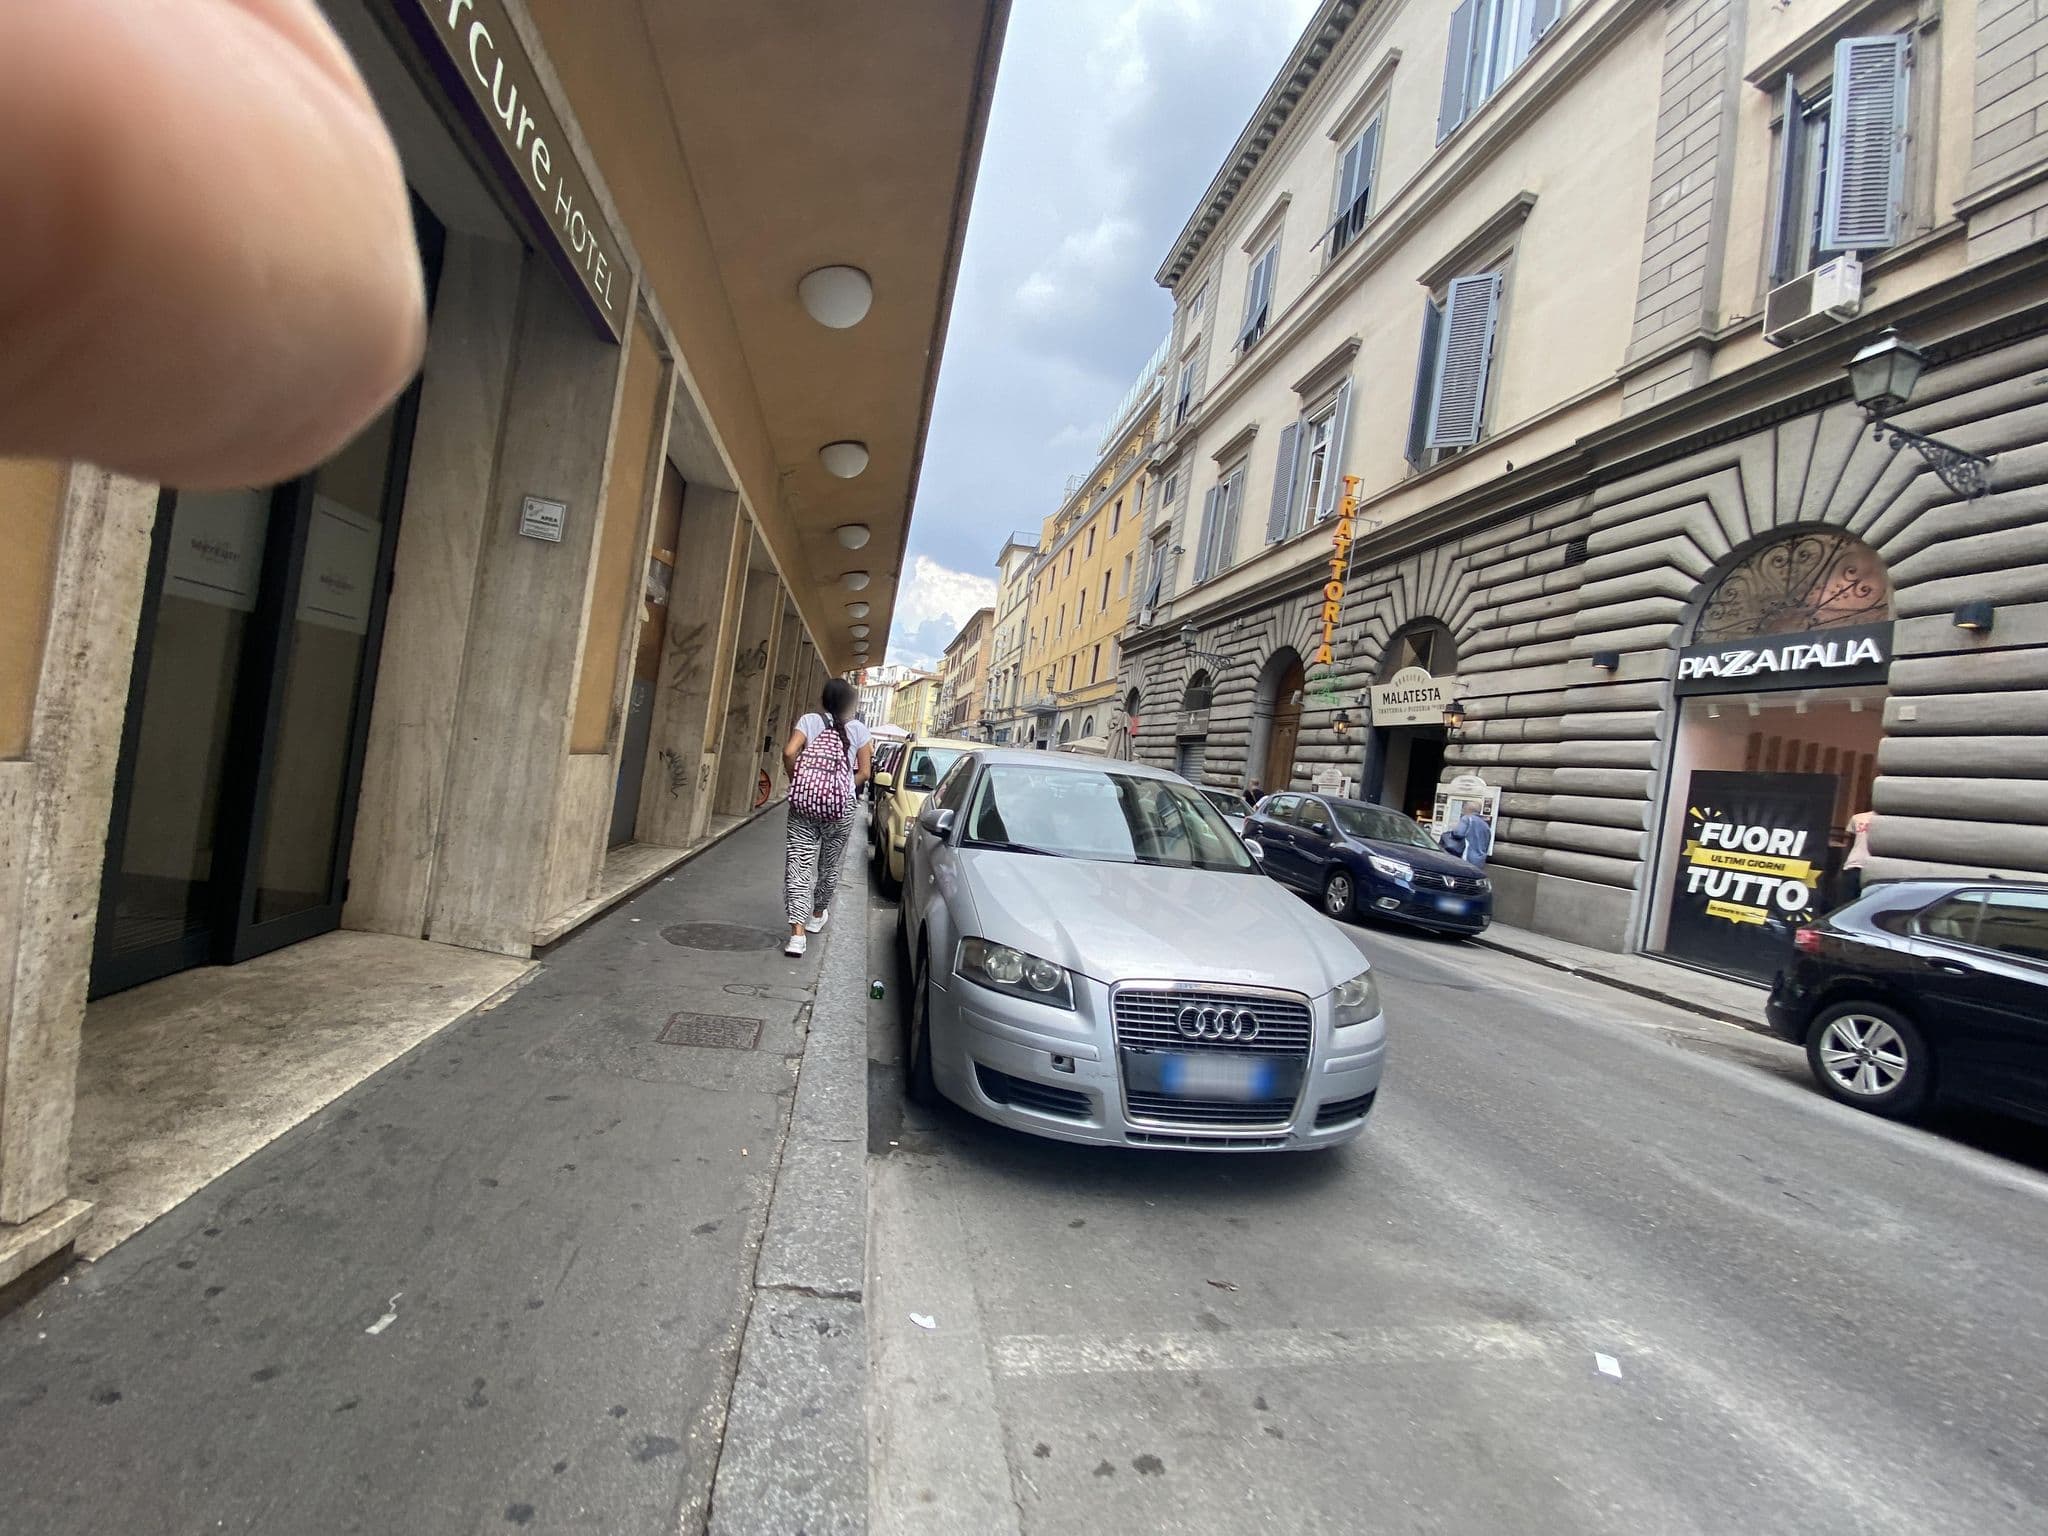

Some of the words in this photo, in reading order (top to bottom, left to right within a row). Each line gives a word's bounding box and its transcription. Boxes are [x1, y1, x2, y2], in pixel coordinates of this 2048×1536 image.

[440, 0, 550, 191] rcure
[554, 177, 612, 310] HOTEL
[1314, 475, 1361, 665] TRATTORIA
[1382, 687, 1441, 705] MALATESTA
[1700, 822, 1808, 857] FUORI
[1711, 854, 1746, 866] ULTIMI
[1747, 859, 1786, 871] GIORNI
[1687, 866, 1809, 911] TUTTO
